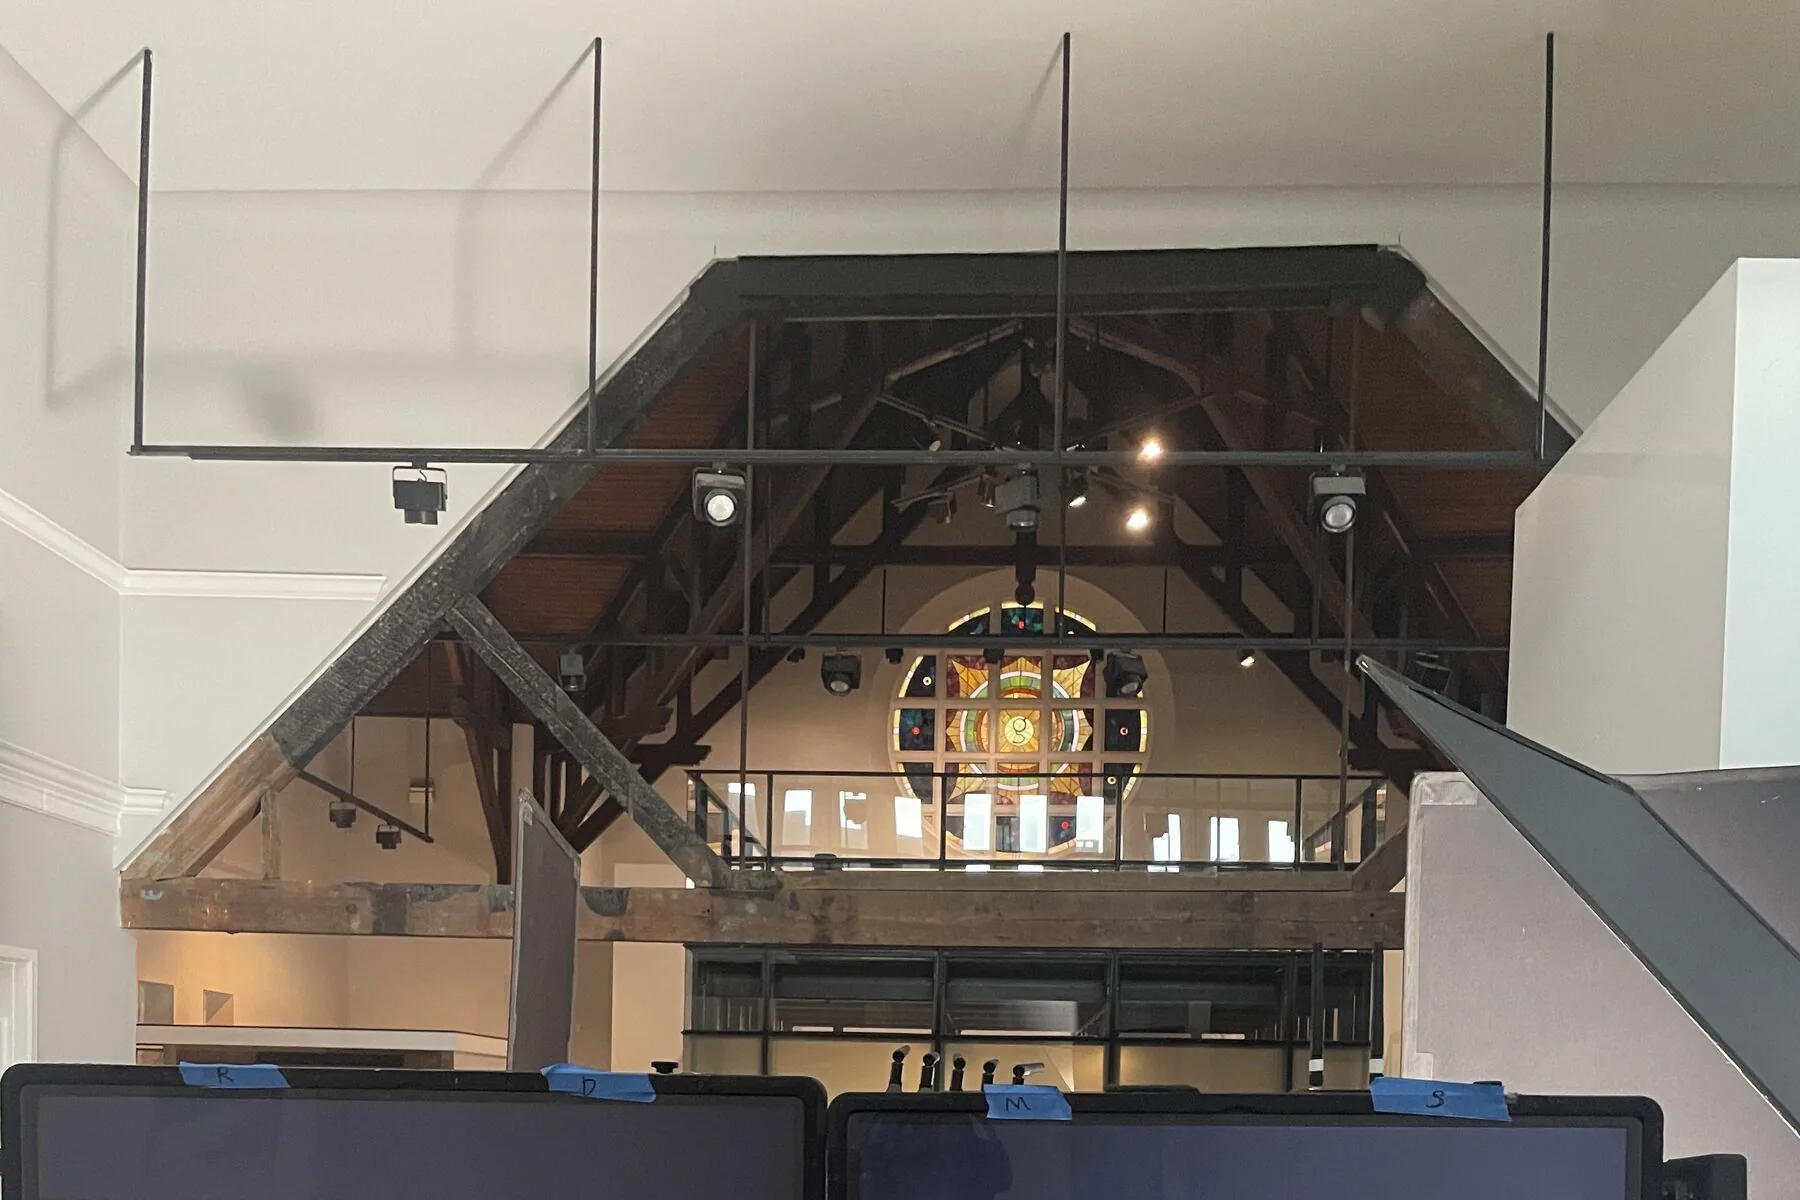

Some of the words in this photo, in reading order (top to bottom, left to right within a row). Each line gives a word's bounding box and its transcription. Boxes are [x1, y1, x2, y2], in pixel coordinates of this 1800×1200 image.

[217, 1066, 234, 1084] R
[581, 1076, 596, 1097] D
[1005, 1097, 1032, 1112] M
[1426, 1089, 1446, 1109] S
